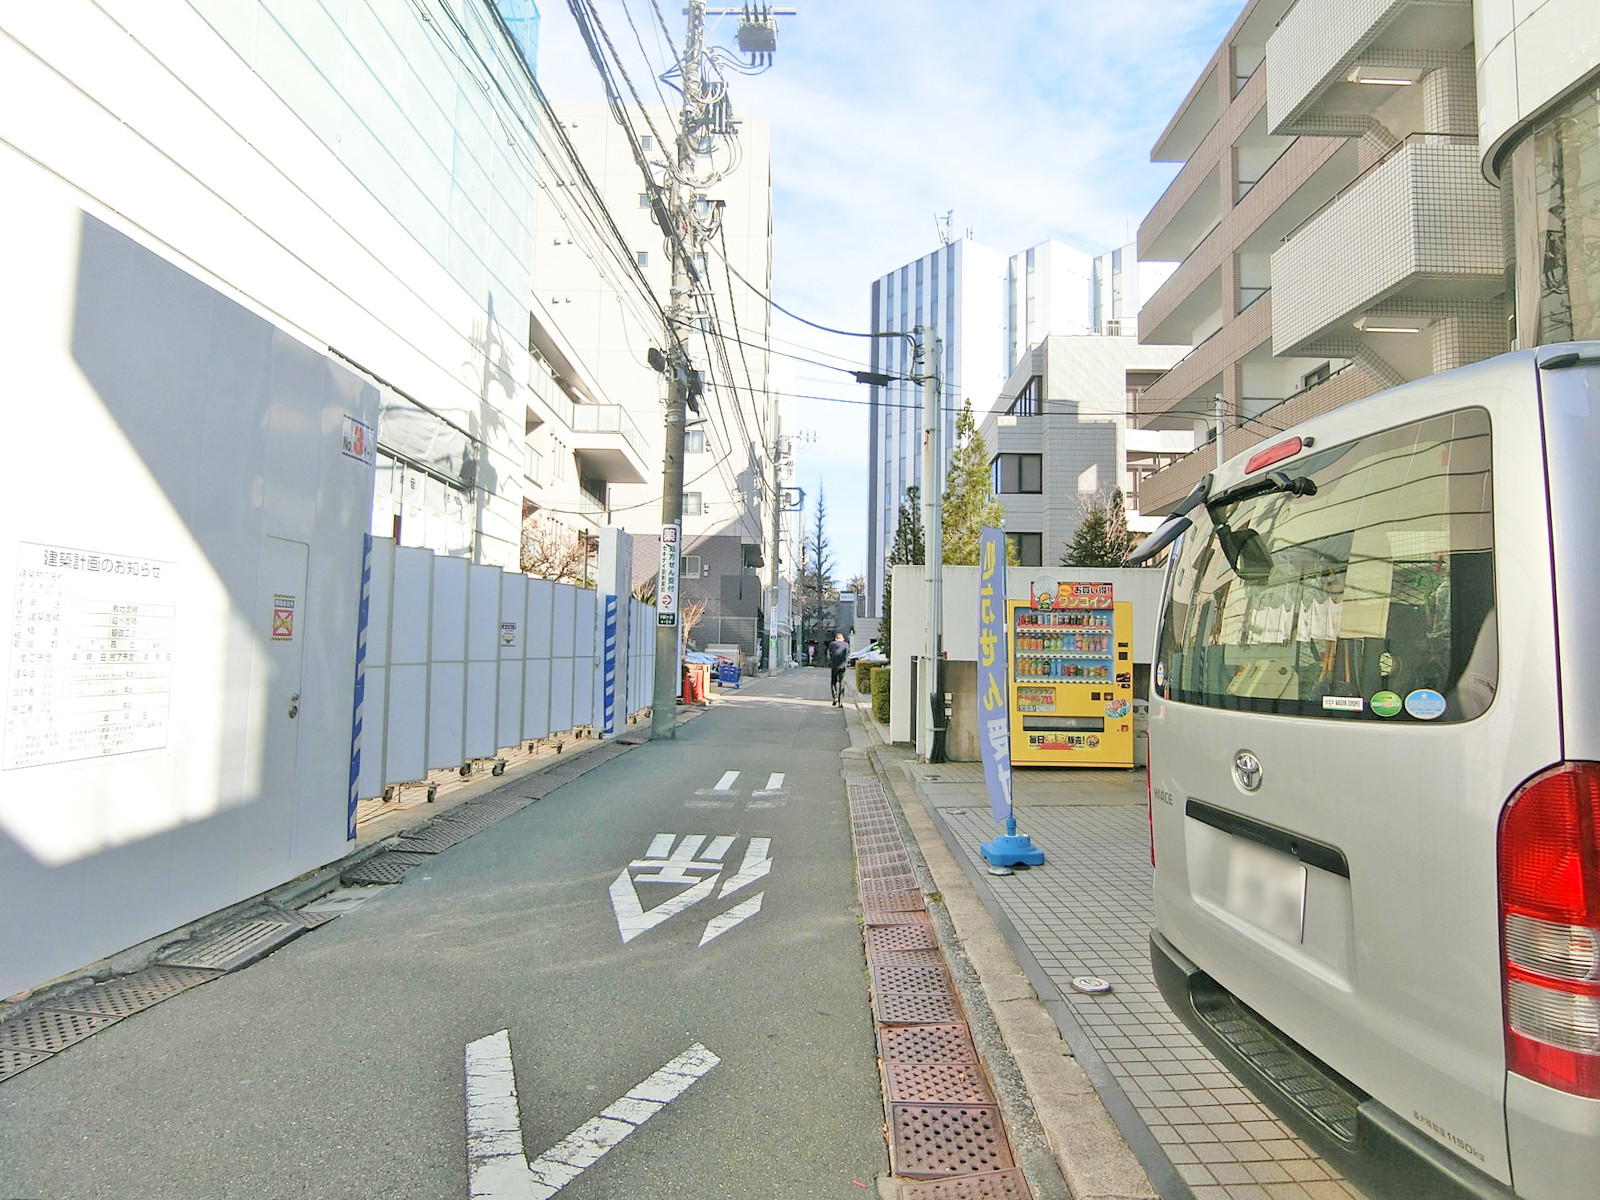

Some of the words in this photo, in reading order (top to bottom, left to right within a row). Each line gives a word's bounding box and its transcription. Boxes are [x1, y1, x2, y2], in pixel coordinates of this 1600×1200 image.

[44, 550, 160, 578] 建築計画のお知らせ
[1059, 597, 1111, 607] ワンコイン
[1154, 787, 1173, 806] HIACE
